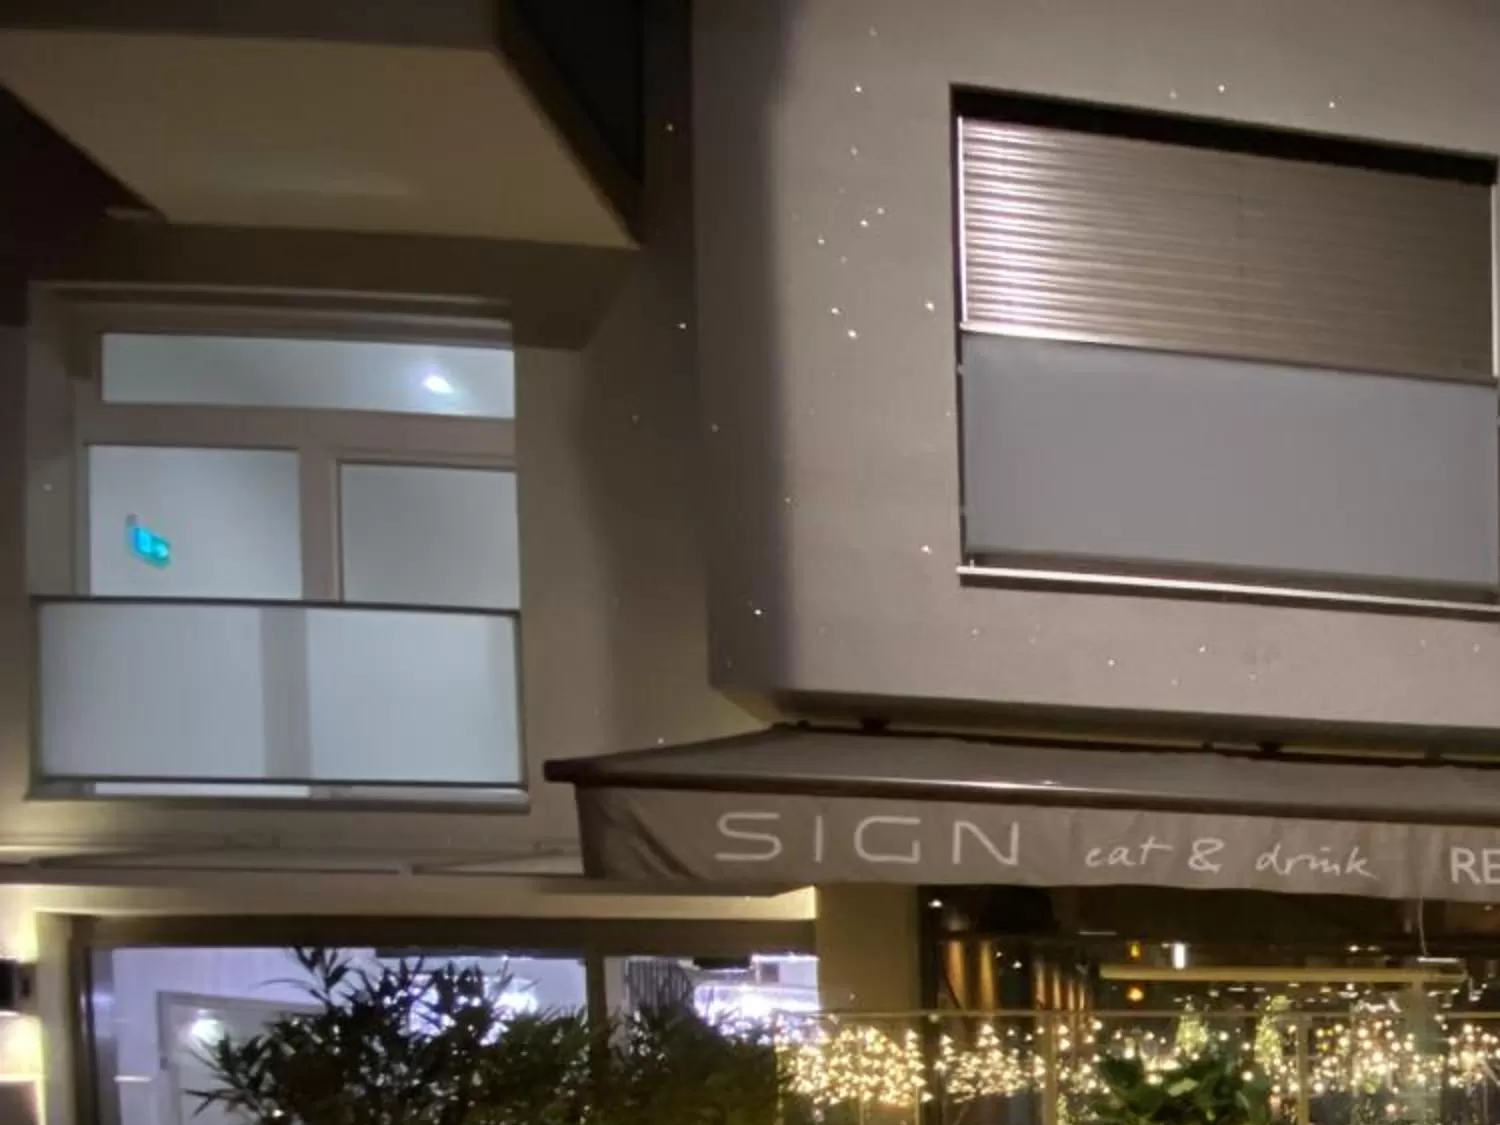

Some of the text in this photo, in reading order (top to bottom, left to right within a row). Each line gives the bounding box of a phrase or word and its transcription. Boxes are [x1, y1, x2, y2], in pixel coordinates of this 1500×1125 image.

[714, 811, 1381, 881] SIGN eat & drink
